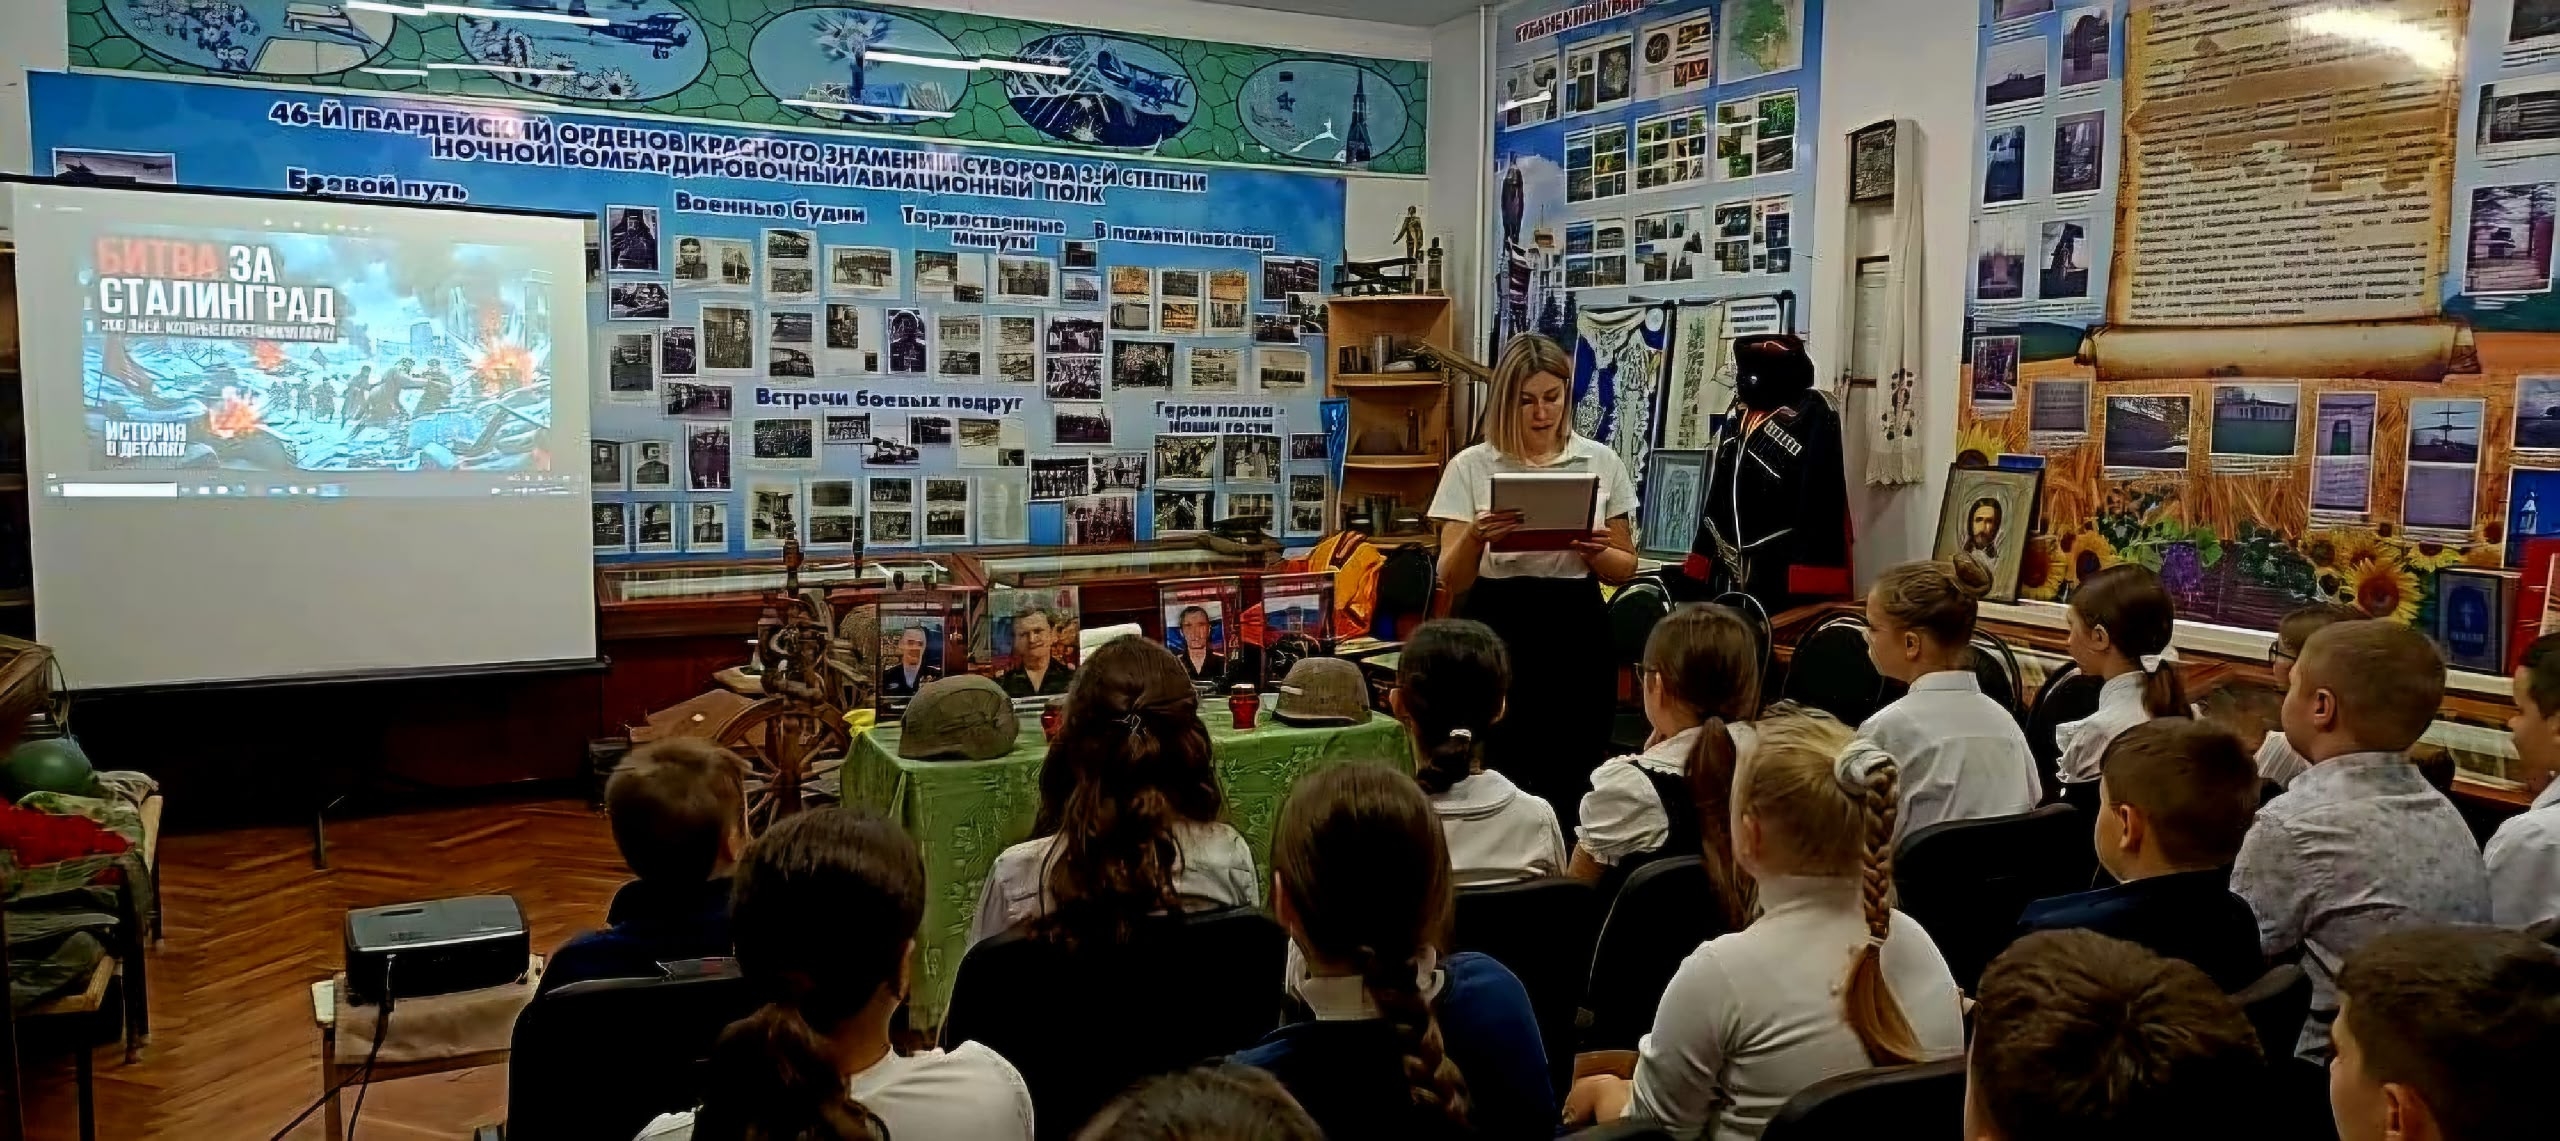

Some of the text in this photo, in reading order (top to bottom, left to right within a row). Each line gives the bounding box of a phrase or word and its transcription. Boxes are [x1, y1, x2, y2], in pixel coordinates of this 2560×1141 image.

[271, 101, 343, 128] 46-Й
[351, 106, 552, 143] ГВАРДЕЙСКИЙ
[559, 125, 684, 152] ОРДЕНОВ
[691, 134, 818, 162] КРАСНОГО
[825, 145, 936, 171] ЗНАМЕНИ
[963, 157, 1076, 183] СУВОРОВА
[1081, 162, 1117, 185] 3-Й
[1122, 169, 1207, 192] СТЕПЕНИ
[434, 137, 1104, 202] НОЧНОЙ БОМБАРДИРОВОЧНЫЙ АВИАЦИОННЫЙ ПОЛК
[403, 182, 467, 200] путь
[676, 191, 866, 224] Военные будни
[903, 206, 1065, 233] Торжественные
[953, 232, 1035, 251] минуты
[1094, 222, 1274, 250] В памяти навсегда
[97, 238, 276, 283] БИТВА ЗА
[100, 277, 336, 325] СТАЛИНГРАД
[755, 387, 1024, 415] Встречи боевых подруг
[1155, 401, 1212, 420] Герои
[1217, 406, 1273, 418] полка
[106, 420, 187, 441] ИСТОРИЯ
[1168, 420, 1273, 434] наши гости
[106, 441, 187, 457] В ДЕТАЛЯХ
